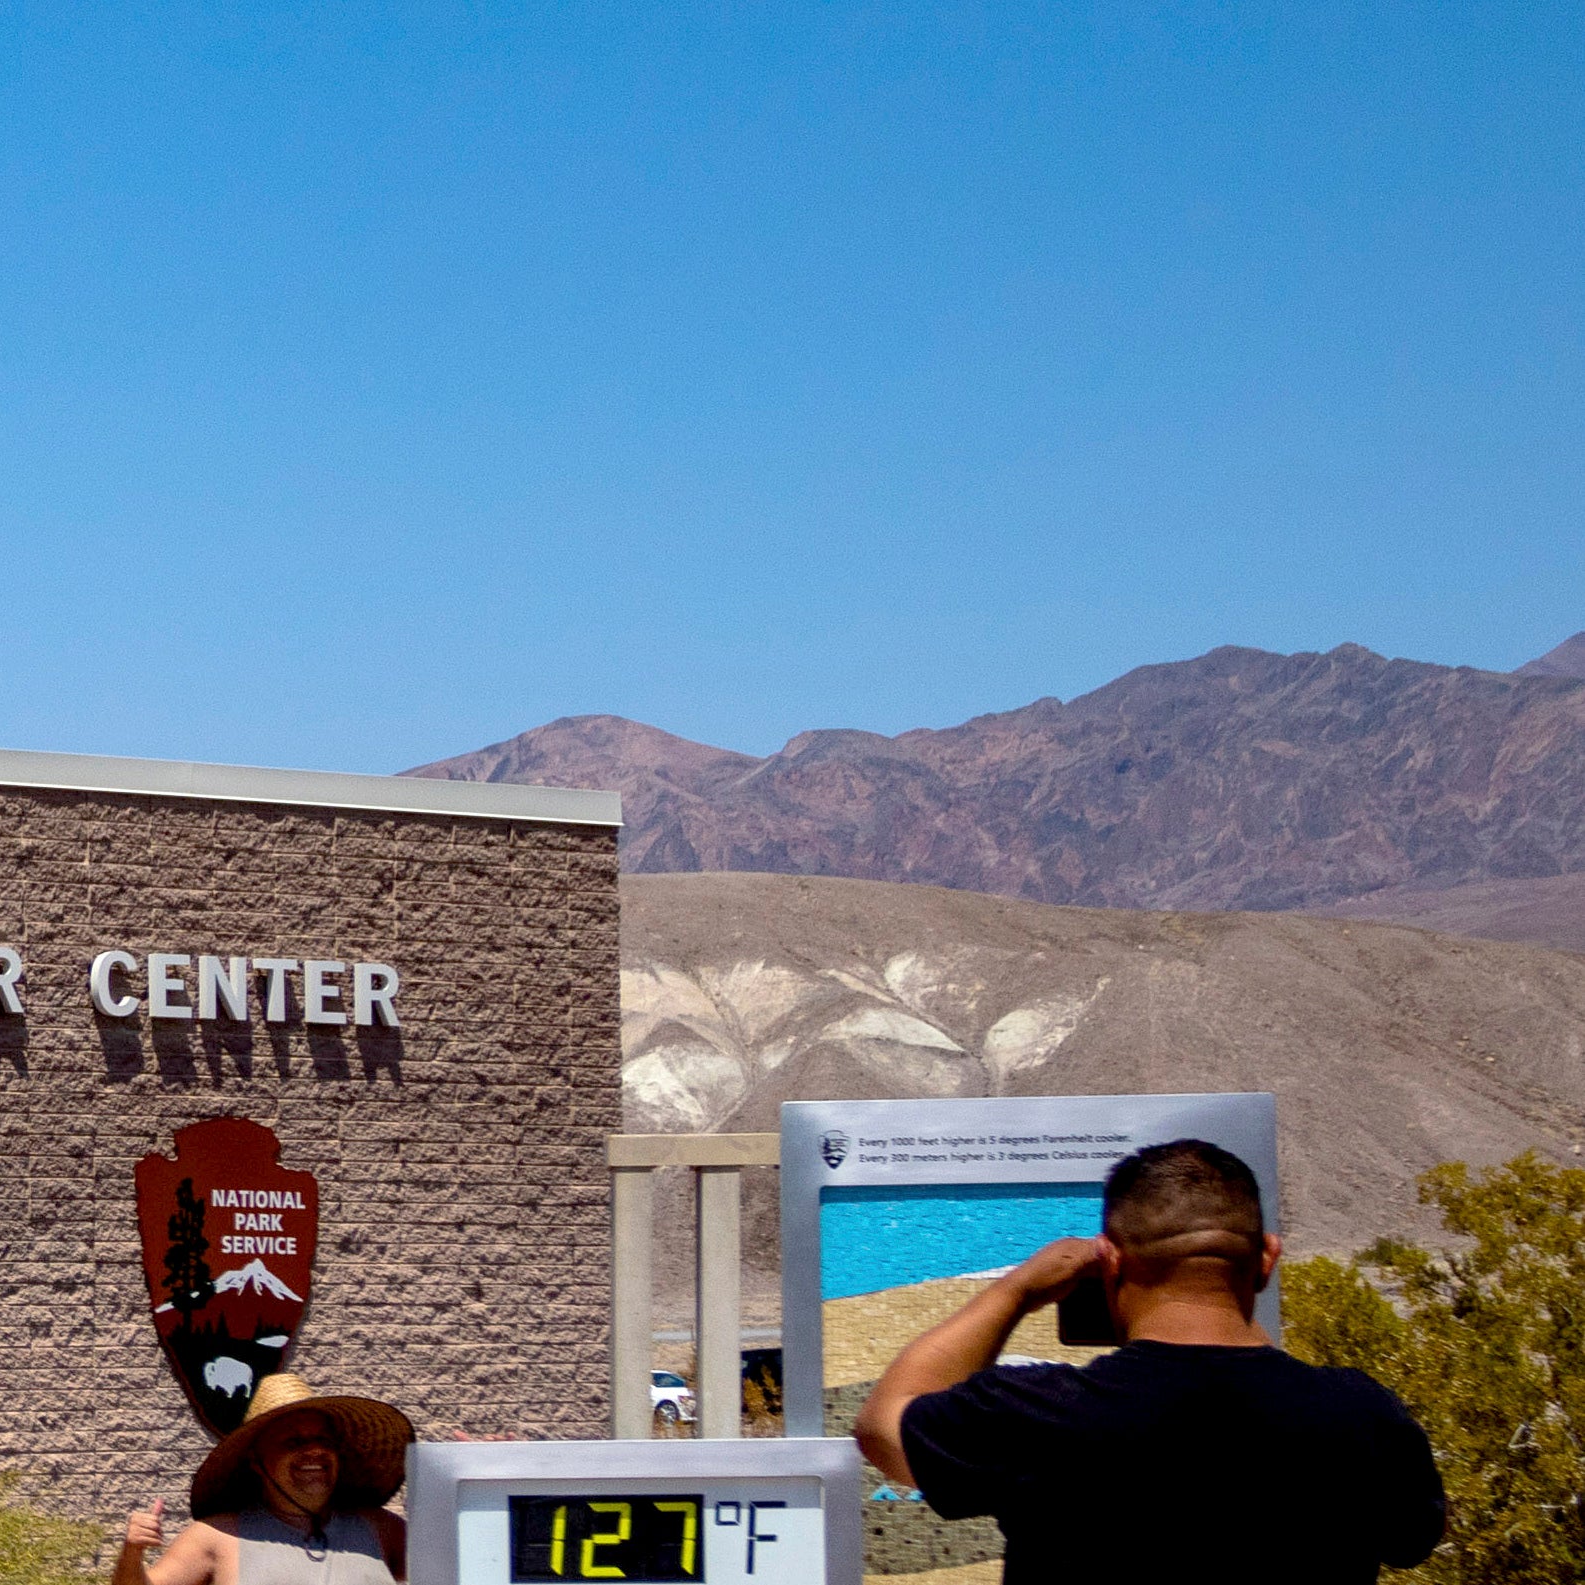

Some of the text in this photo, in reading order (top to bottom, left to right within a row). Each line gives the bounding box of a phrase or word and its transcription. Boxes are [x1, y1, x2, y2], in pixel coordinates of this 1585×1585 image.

[90, 949, 402, 1026] CENTER
[858, 1137, 887, 1149] Every
[891, 1137, 915, 1146] 1000
[917, 1136, 939, 1146] feet
[941, 1135, 975, 1147] higher
[978, 1135, 986, 1145] is
[989, 1135, 996, 1145] 5
[998, 1135, 1040, 1146] degrees
[858, 1153, 887, 1164] Every
[890, 1153, 910, 1162] 300
[912, 1154, 948, 1162] meters
[950, 1152, 984, 1164] higher
[987, 1151, 996, 1161] is
[998, 1151, 1005, 1161] 3
[1008, 1151, 1049, 1163] degrees
[1051, 1150, 1088, 1160] Celsius
[211, 1189, 306, 1210] NATIONAL
[234, 1213, 284, 1232] PARK
[221, 1235, 298, 1255] SERVICE
